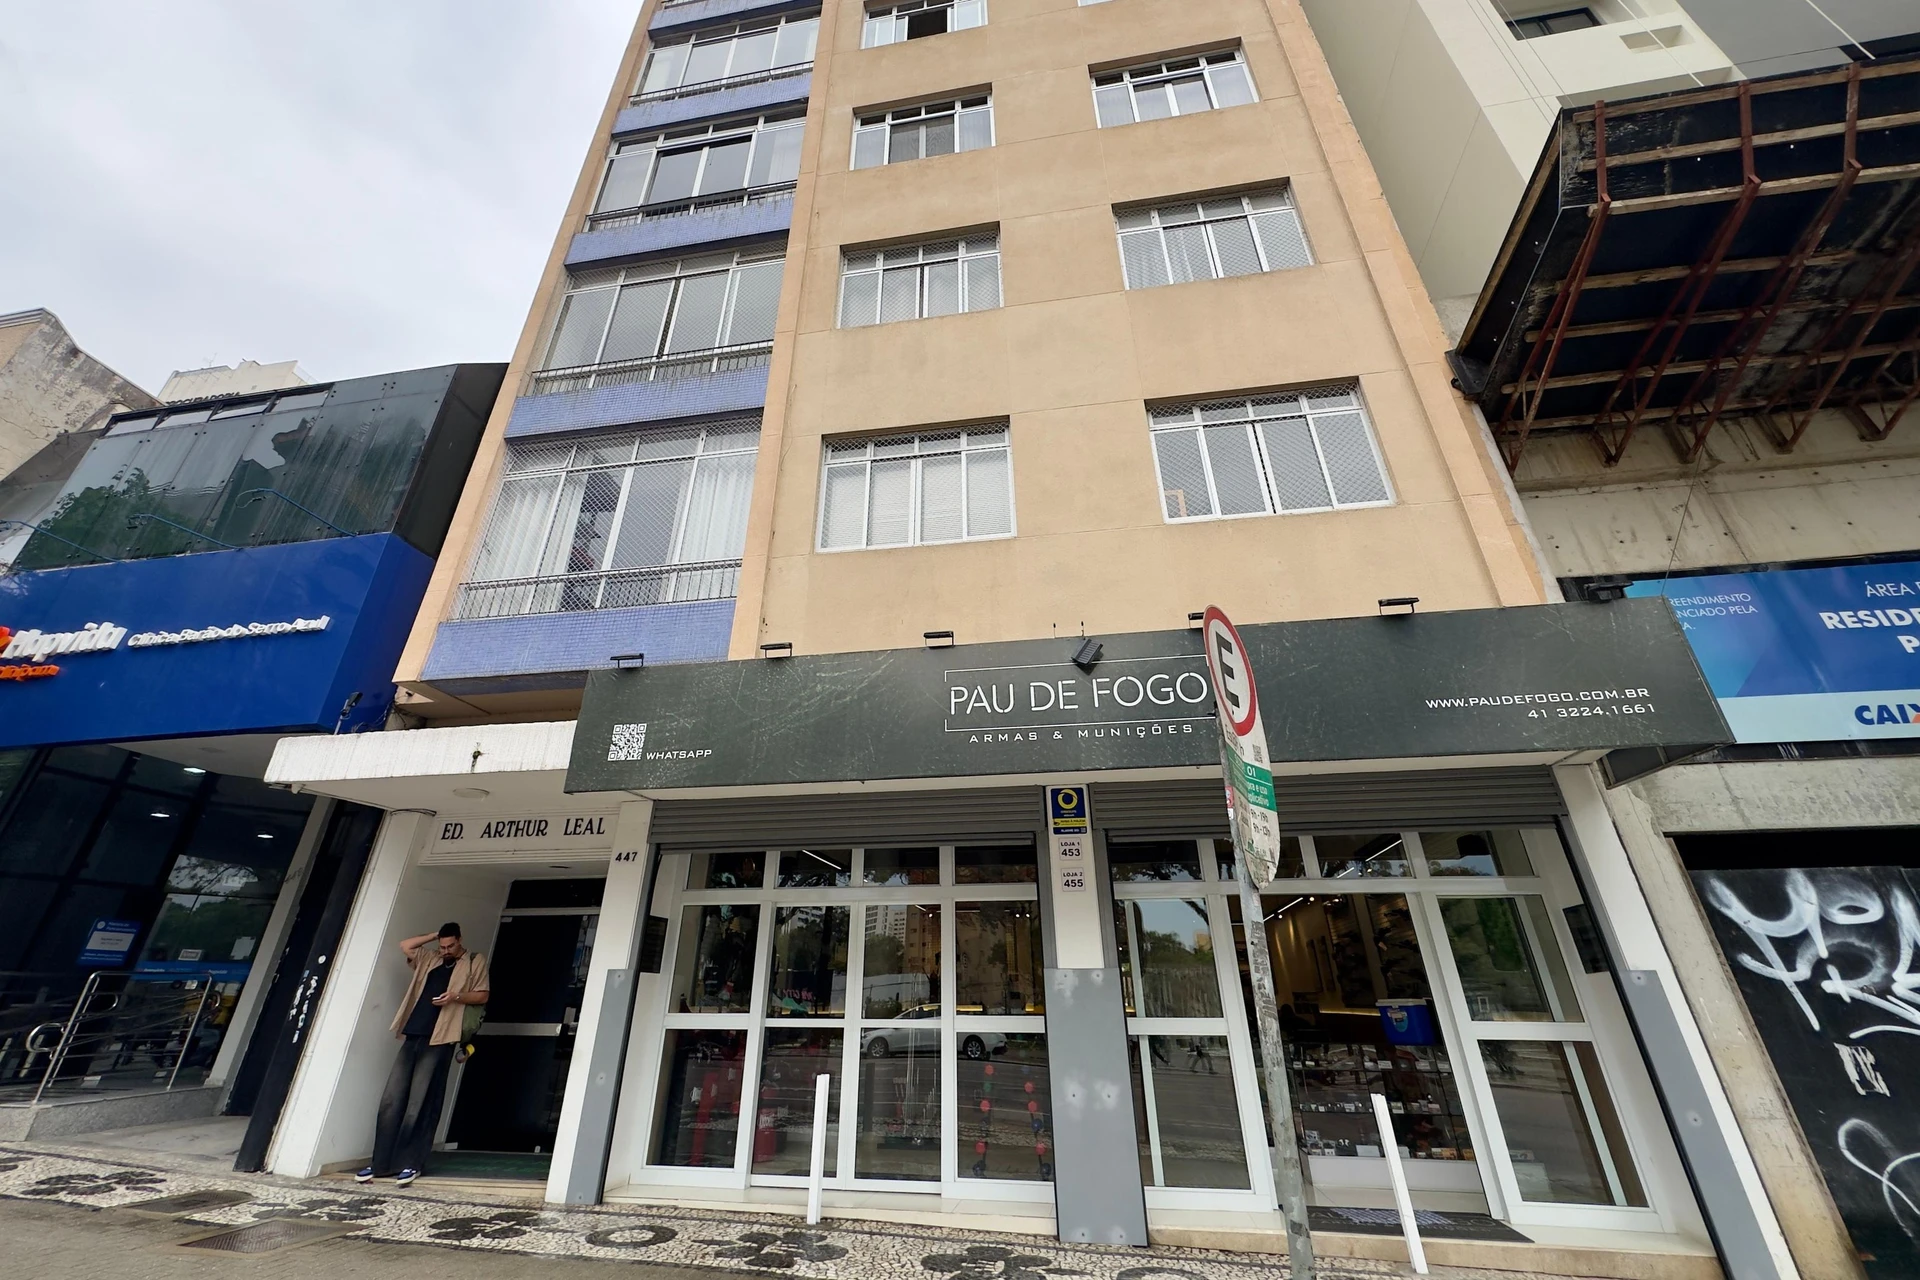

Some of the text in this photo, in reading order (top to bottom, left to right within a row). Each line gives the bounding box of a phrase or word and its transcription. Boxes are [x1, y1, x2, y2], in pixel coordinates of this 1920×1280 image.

[1864, 581, 1916, 598] ÁREA
[1728, 605, 1759, 615] PELA
[291, 615, 331, 632] Azul
[1, 621, 128, 663] Hapvida
[1215, 631, 1240, 710] E
[950, 672, 1208, 716] PAU DE FOGO
[1425, 687, 1650, 709] WWW.PAUDEFOGO.COM.BR
[1527, 703, 1656, 719] 41 3224.1661
[968, 723, 1193, 744] ARMAS & MUNIÇÕES
[645, 749, 713, 760] WHATSAPP
[440, 817, 606, 841] ED. ARTHUR LEAL
[614, 851, 638, 862] 447
[1061, 848, 1081, 857] 453
[1063, 879, 1084, 888] 455
